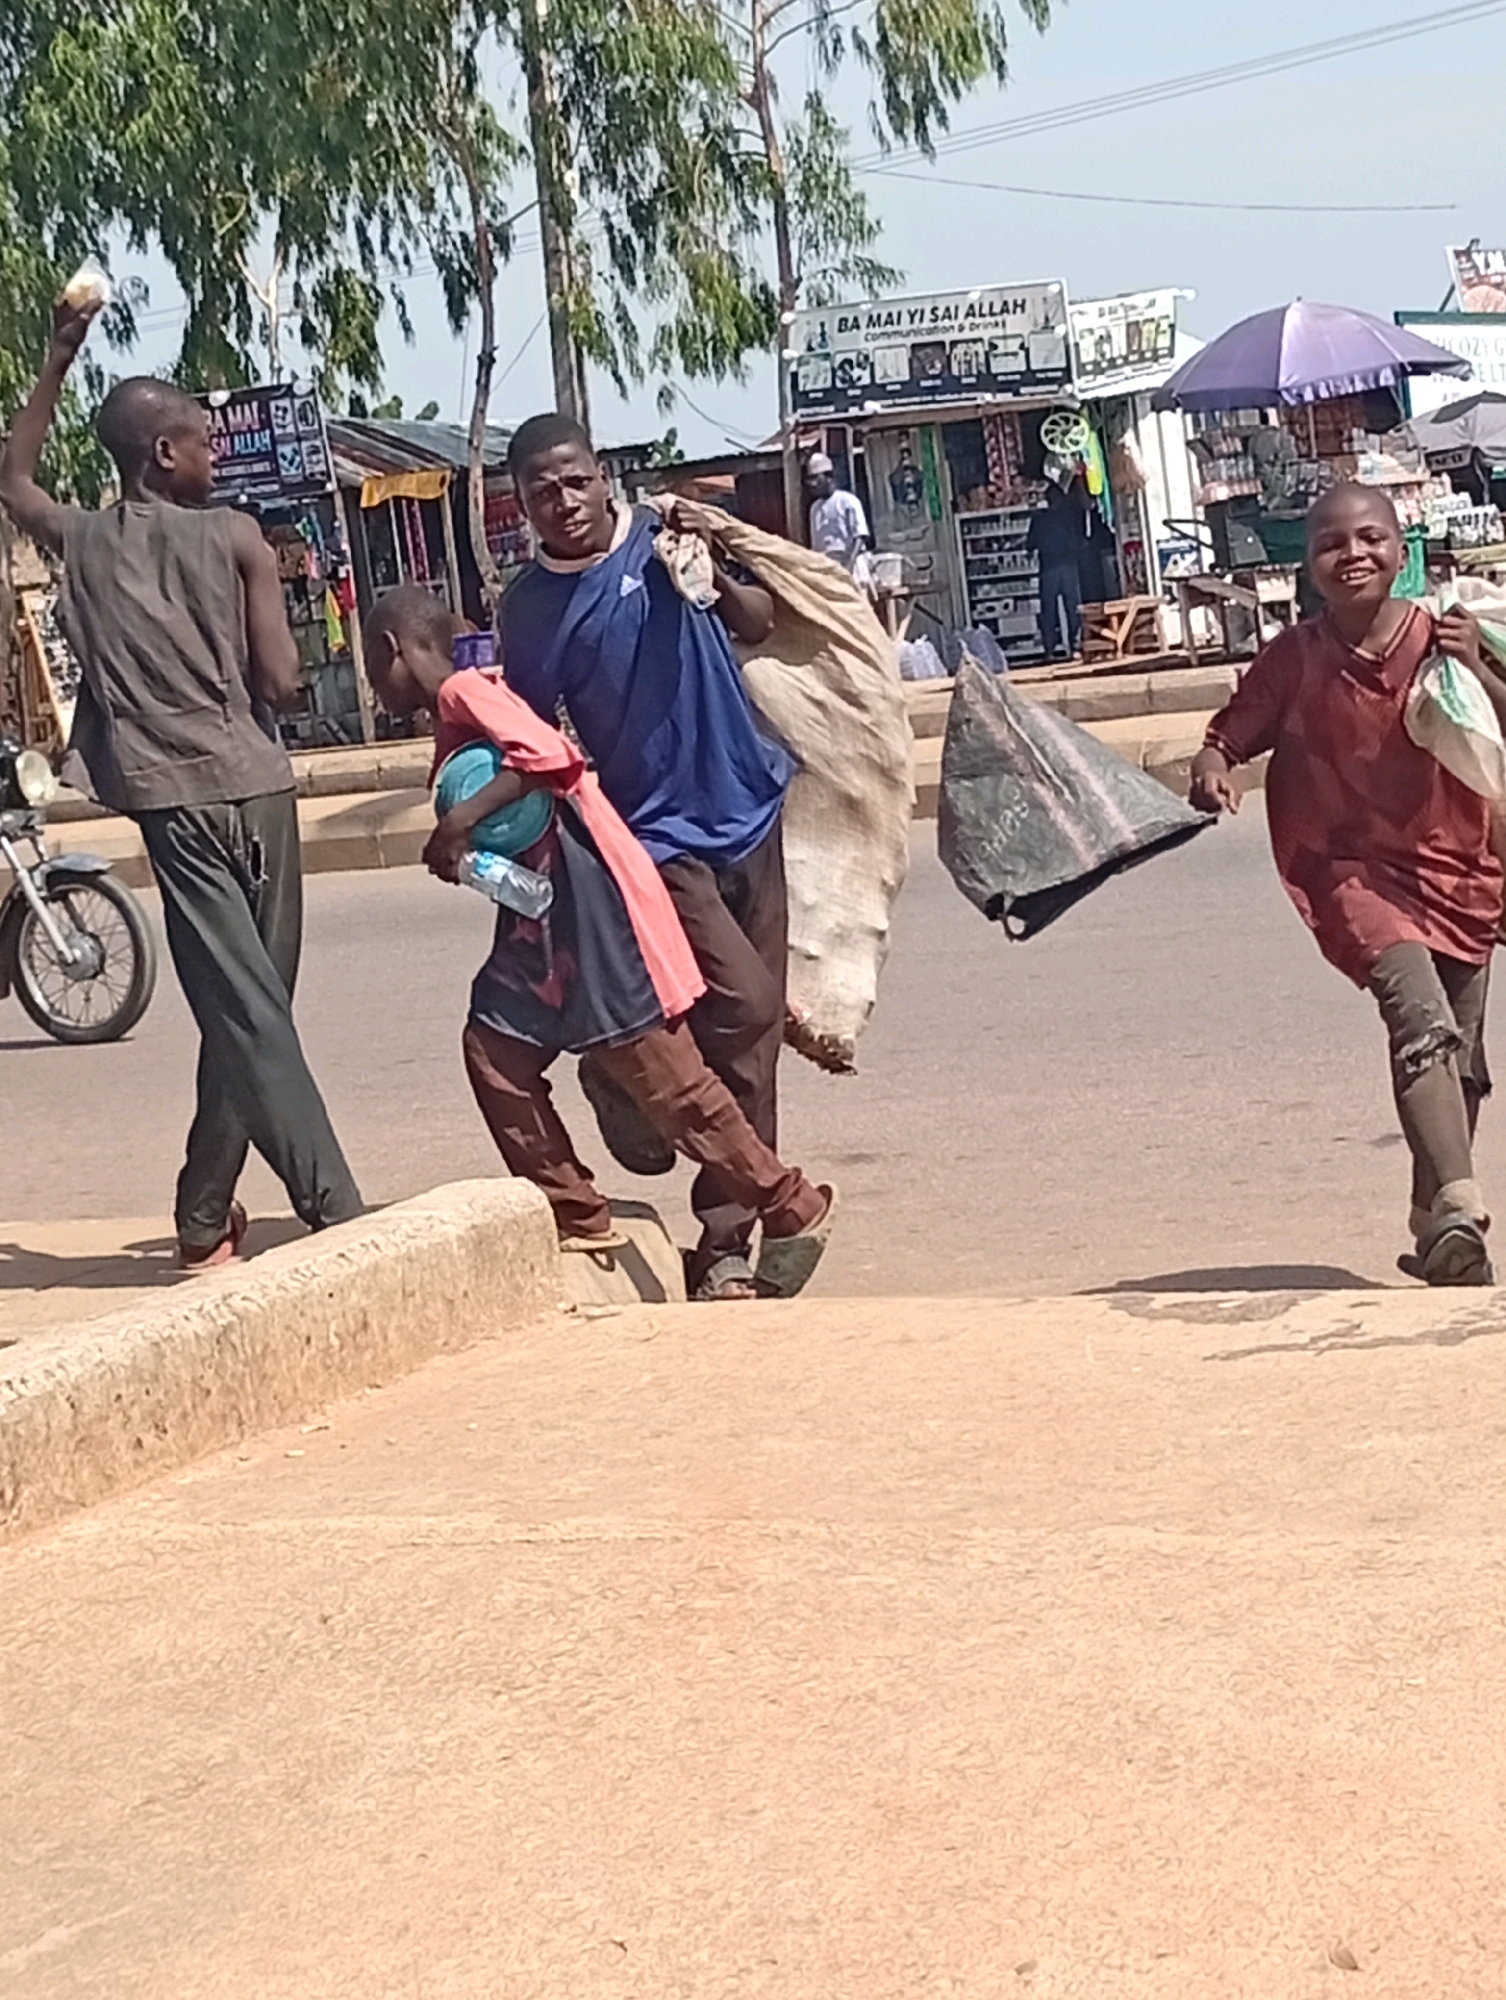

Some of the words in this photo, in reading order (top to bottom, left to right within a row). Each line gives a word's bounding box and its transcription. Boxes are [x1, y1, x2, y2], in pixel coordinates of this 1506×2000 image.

[837, 315, 860, 333] BA
[866, 311, 902, 329] MAI
[907, 308, 925, 325] YI
[929, 305, 959, 323] SAI
[964, 298, 1026, 319] ALLAH
[226, 401, 260, 432] MAI
[233, 429, 272, 455] ALLAH
